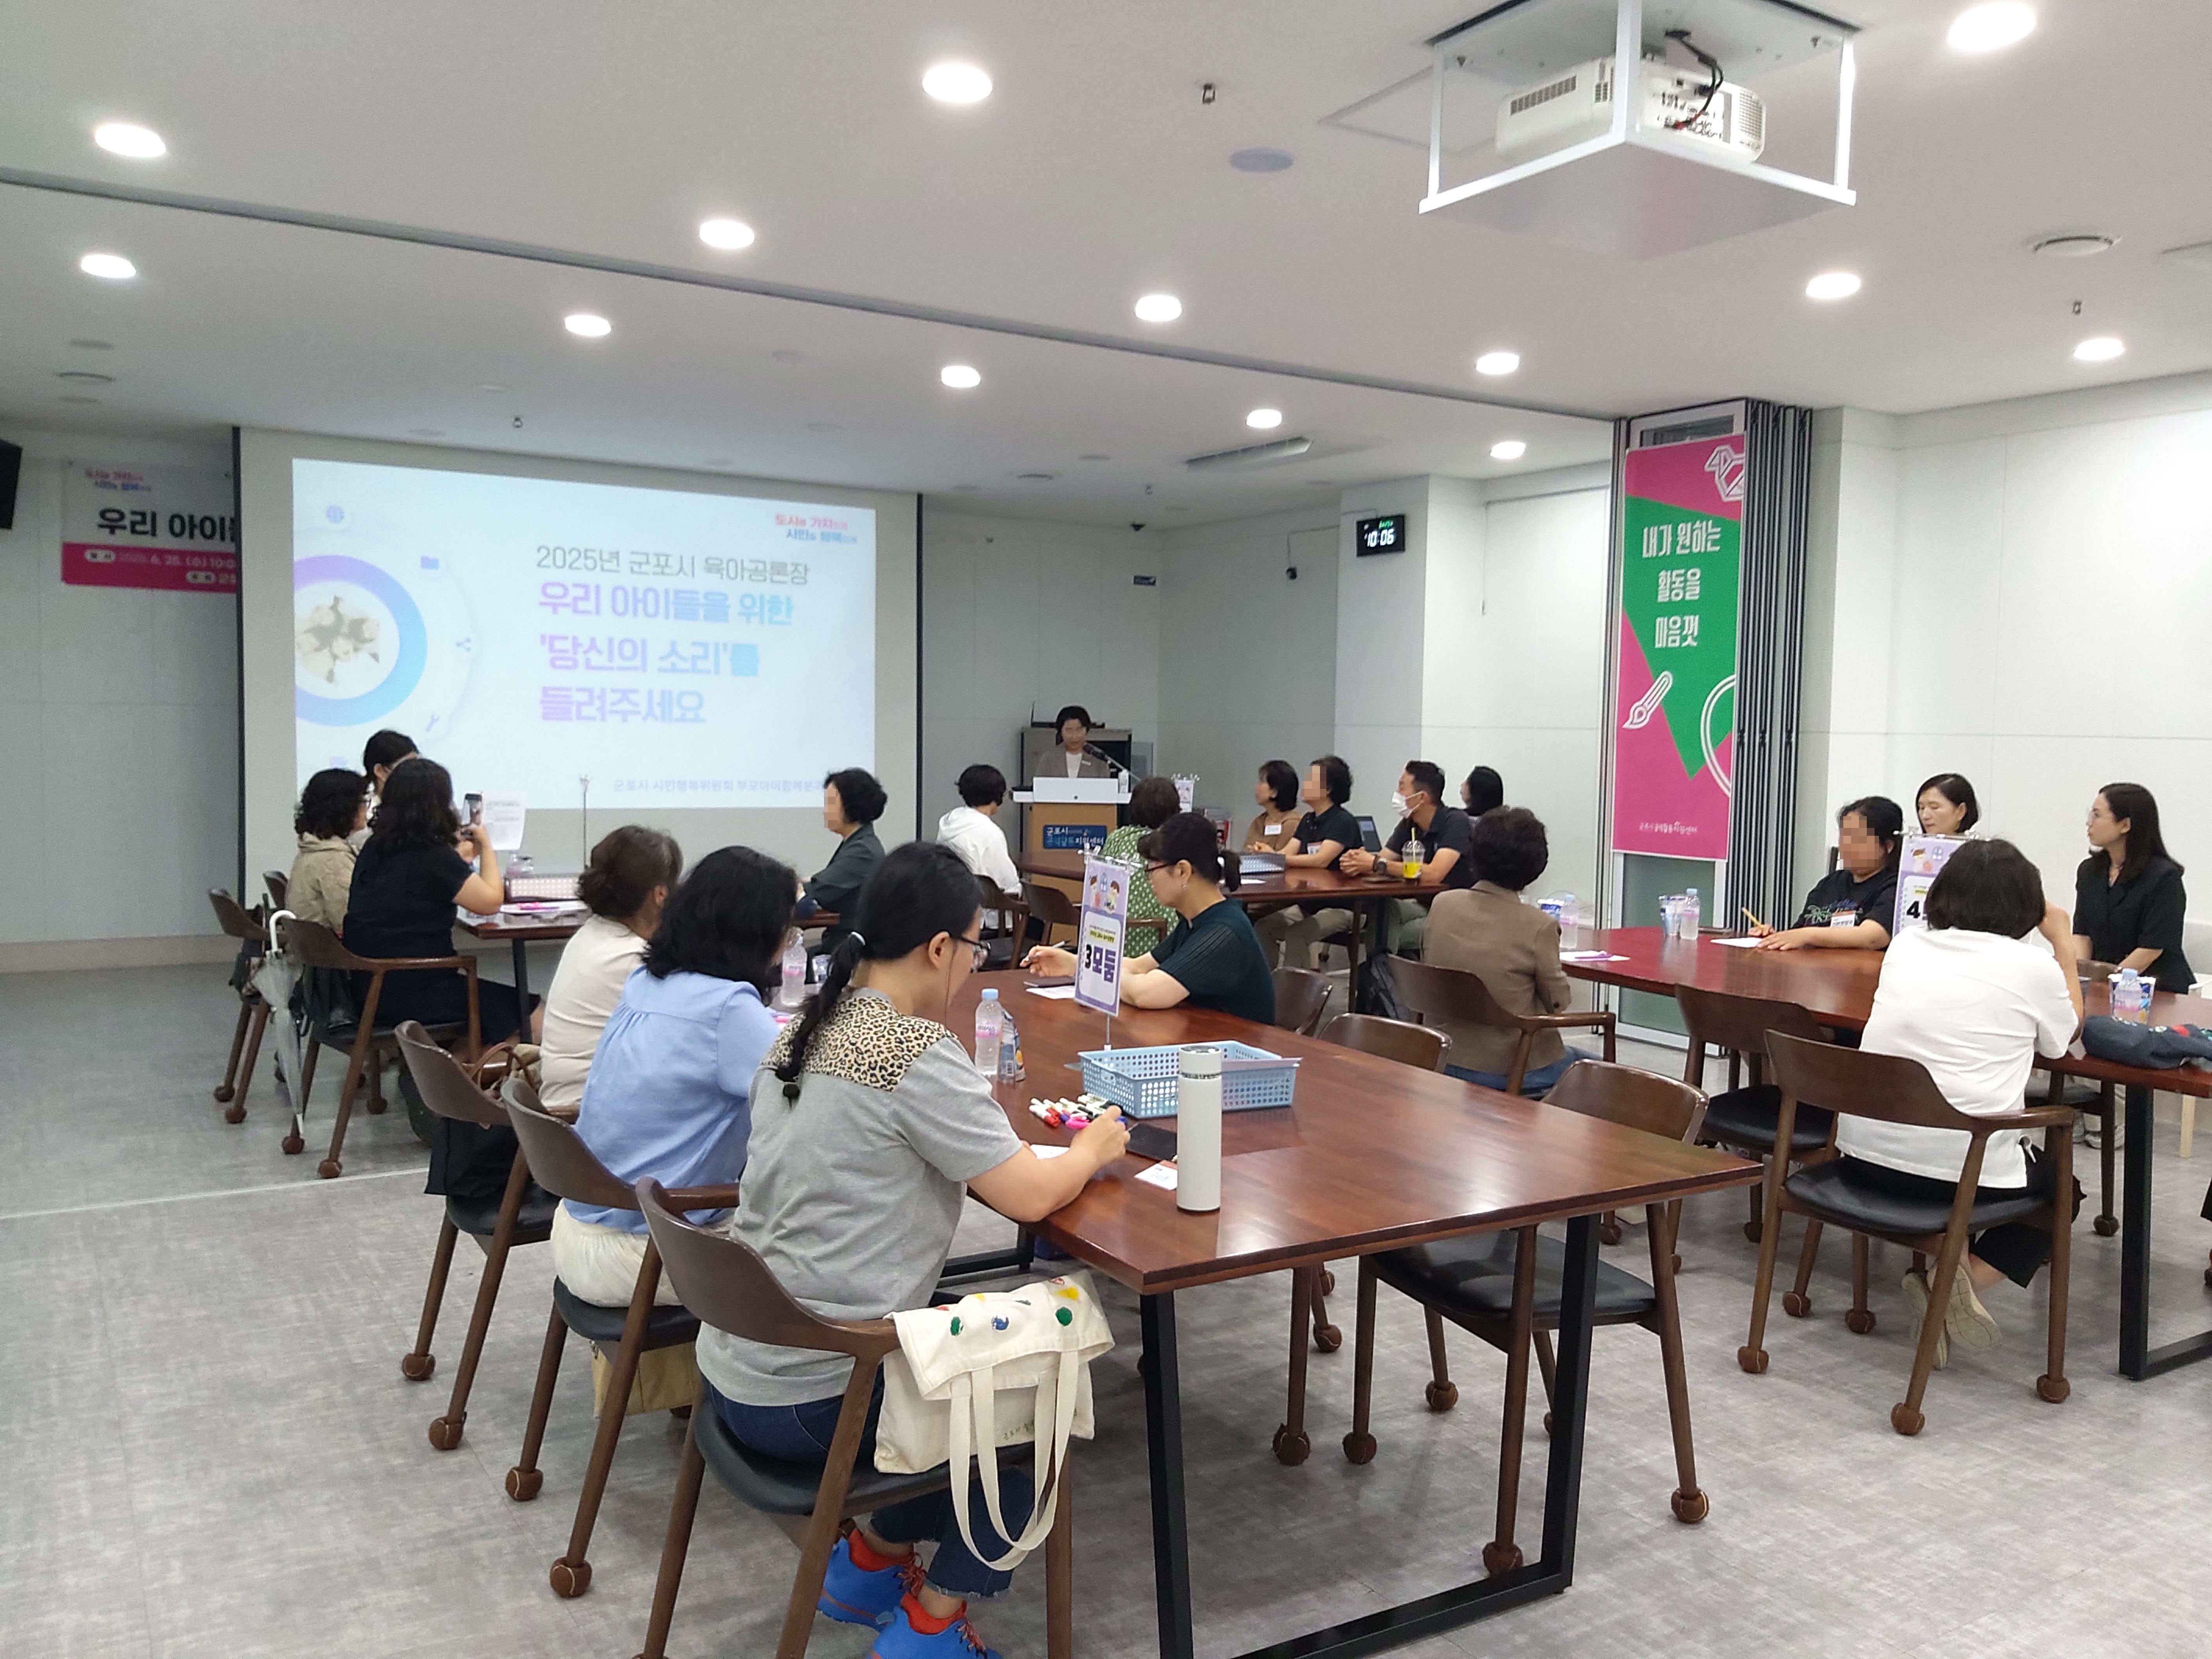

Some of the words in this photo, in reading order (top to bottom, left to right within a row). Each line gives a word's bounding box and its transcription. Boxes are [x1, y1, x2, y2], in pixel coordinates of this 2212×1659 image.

[98, 508, 157, 537] 우리
[169, 513, 235, 542] 아이
[1367, 528, 1394, 547] 10:06
[1642, 524, 1672, 558] 내가
[1676, 520, 1721, 555] 원하는
[537, 545, 621, 573] 2025년
[629, 551, 695, 578] 군포시
[704, 556, 810, 585] 육아공론장
[1657, 568, 1701, 602] 활동을
[539, 582, 601, 616] 우리
[611, 585, 730, 623] 아이들을
[738, 593, 794, 626] 위한
[1655, 615, 1699, 648] 마음껏
[540, 634, 647, 673] '당신의
[540, 686, 706, 723] 들려주세요
[614, 779, 648, 792] 군포시
[1047, 827, 1069, 836] 군포시
[1085, 944, 1116, 983] 3모둠
